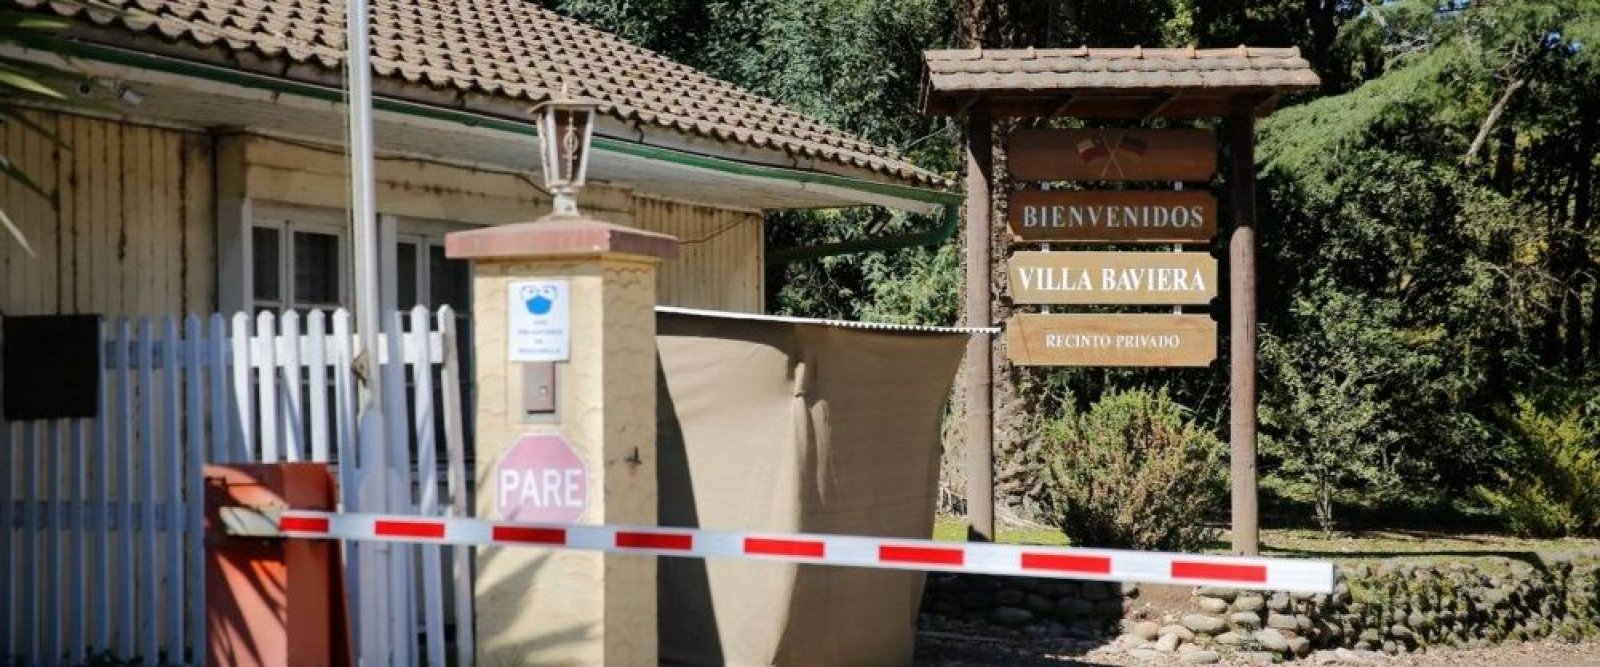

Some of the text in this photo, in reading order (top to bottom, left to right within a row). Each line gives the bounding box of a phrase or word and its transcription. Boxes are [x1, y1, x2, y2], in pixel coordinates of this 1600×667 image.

[1023, 205, 1204, 228] BIENVENIDOS
[1018, 267, 1206, 291] VILLA BAVIERA
[1046, 334, 1180, 349] RECINTO PRIVADO
[501, 468, 583, 507] PARE
